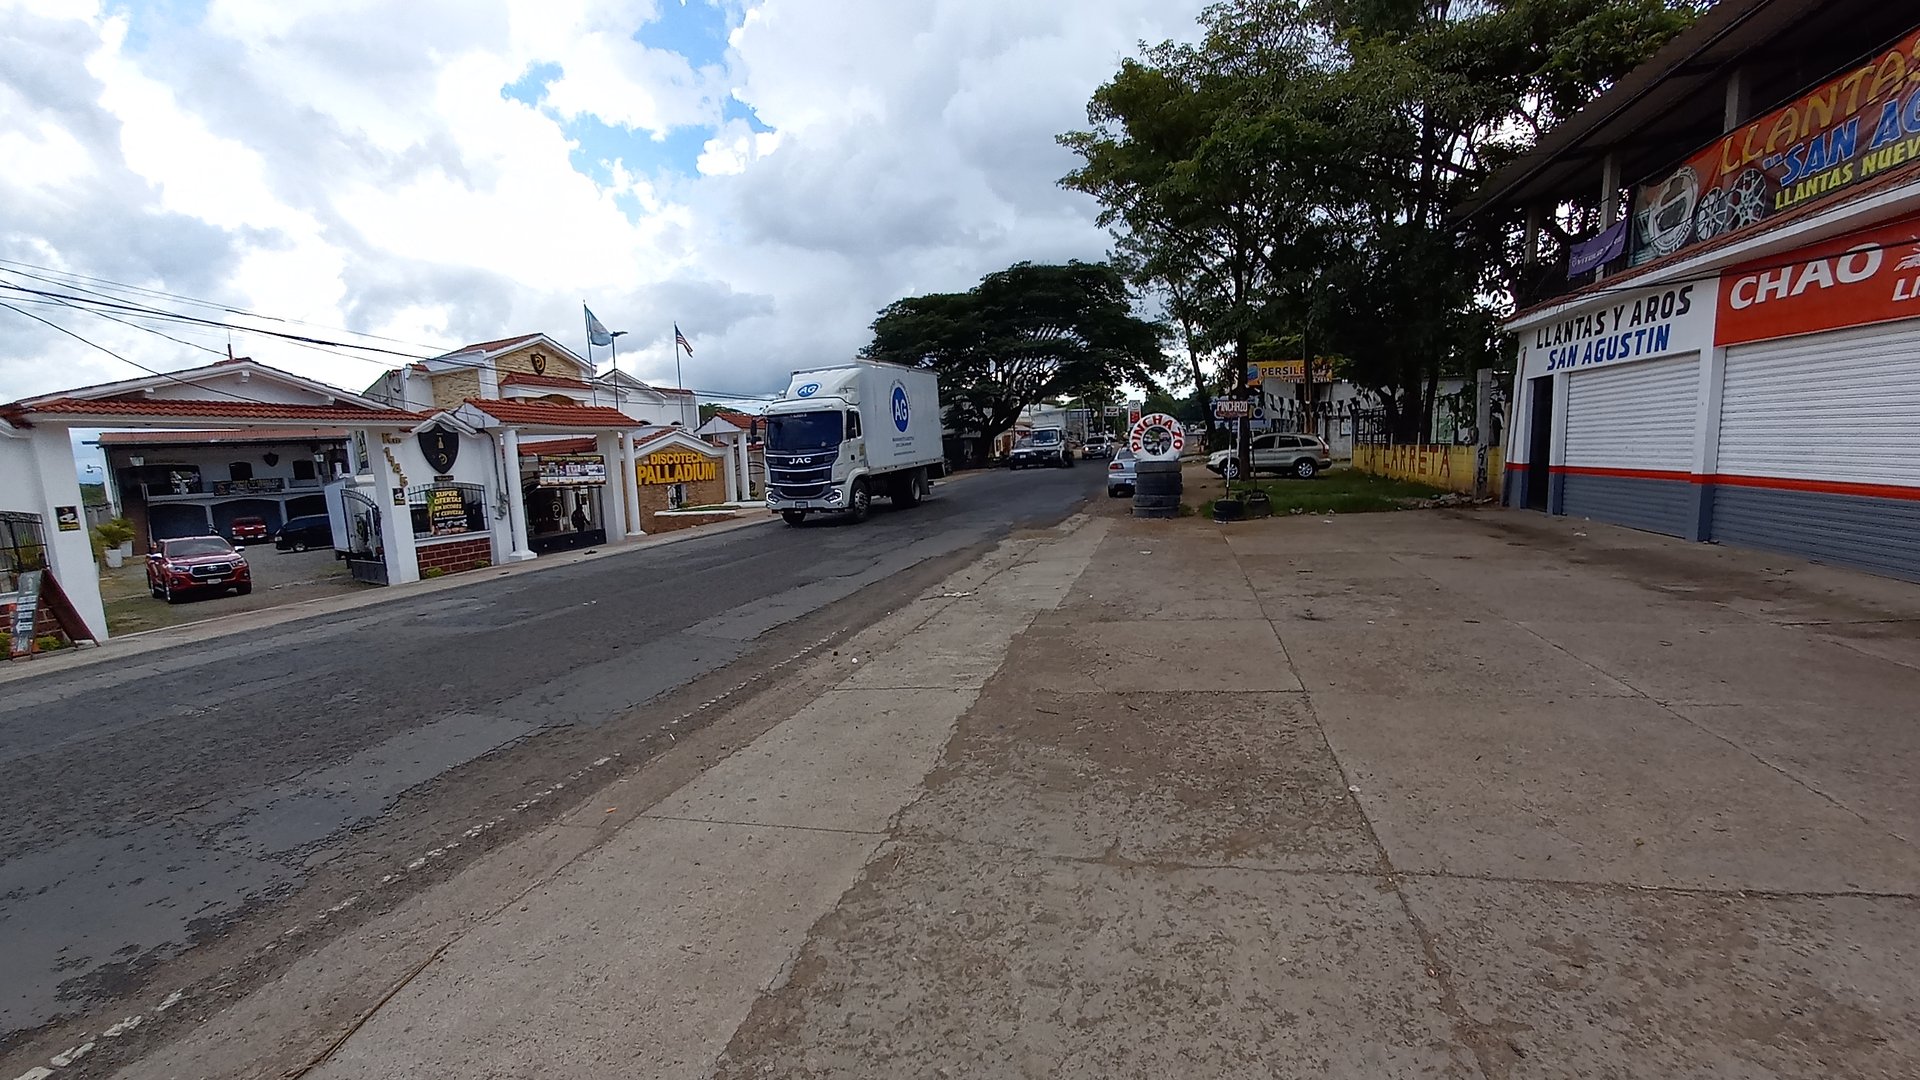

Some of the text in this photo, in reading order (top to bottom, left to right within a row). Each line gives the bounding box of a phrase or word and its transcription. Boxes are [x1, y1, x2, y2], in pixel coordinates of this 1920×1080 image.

[1775, 162, 1853, 210] LLANTAS
[1730, 242, 1883, 310] CHAO
[1536, 284, 1694, 349] LLANTAS Y AROS
[1547, 323, 1671, 371] SAN AGUSTIN
[798, 385, 817, 395] AG
[895, 399, 908, 421] AG
[1217, 401, 1248, 412] PINCHAZO
[1131, 415, 1184, 453] PINCHAZO
[650, 453, 704, 465] DISCOTECA
[788, 457, 812, 465] JAC
[1383, 444, 1451, 478] CARRETA
[637, 463, 716, 486] PALLADIUM
[436, 490, 458, 498] SUPER
